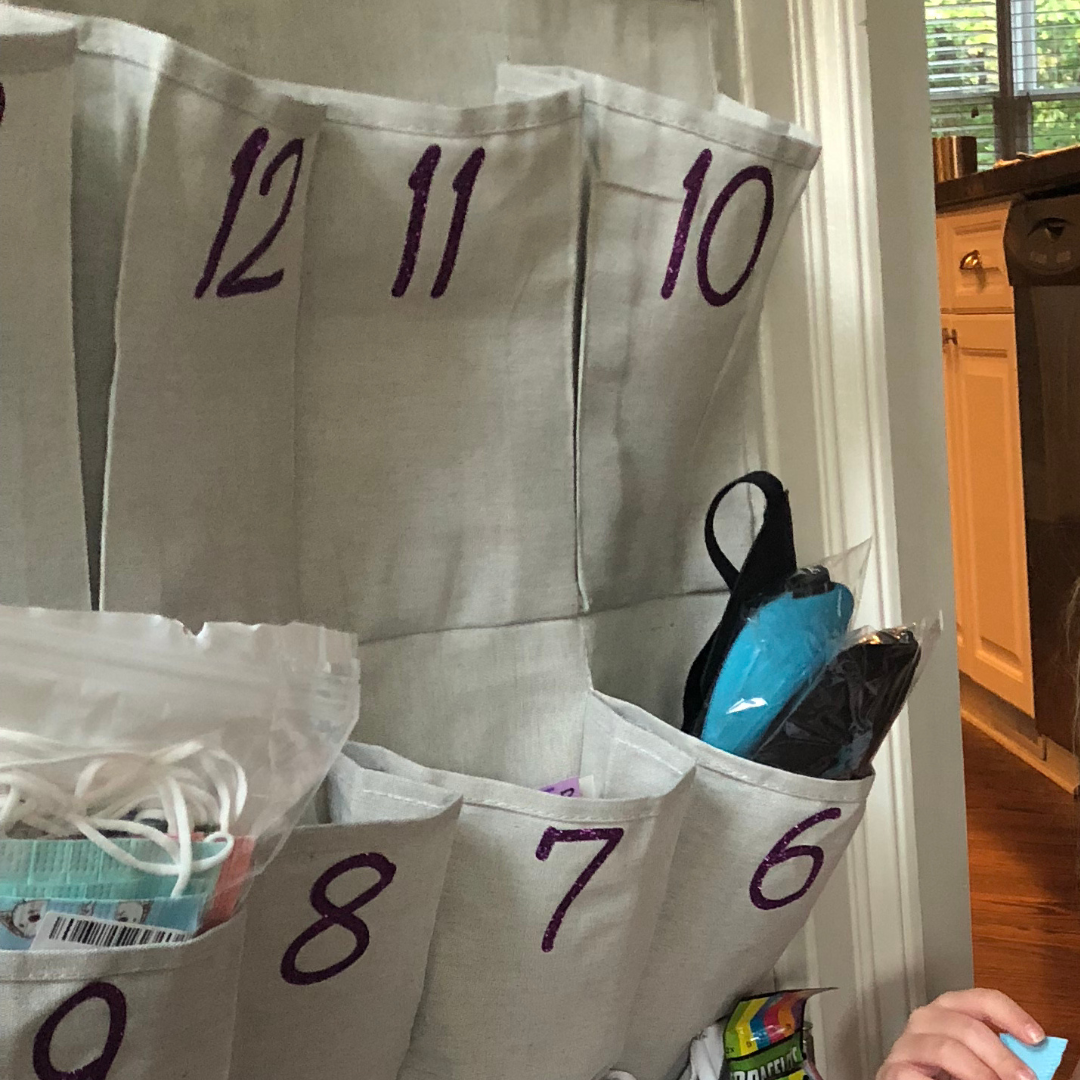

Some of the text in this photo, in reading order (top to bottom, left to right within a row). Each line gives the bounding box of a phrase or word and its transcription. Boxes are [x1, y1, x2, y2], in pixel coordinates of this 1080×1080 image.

[193, 127, 304, 300] 12
[392, 145, 486, 299] 11
[660, 148, 775, 308] 10
[280, 851, 397, 987] 8
[535, 826, 624, 953] 7
[749, 807, 842, 911] 6
